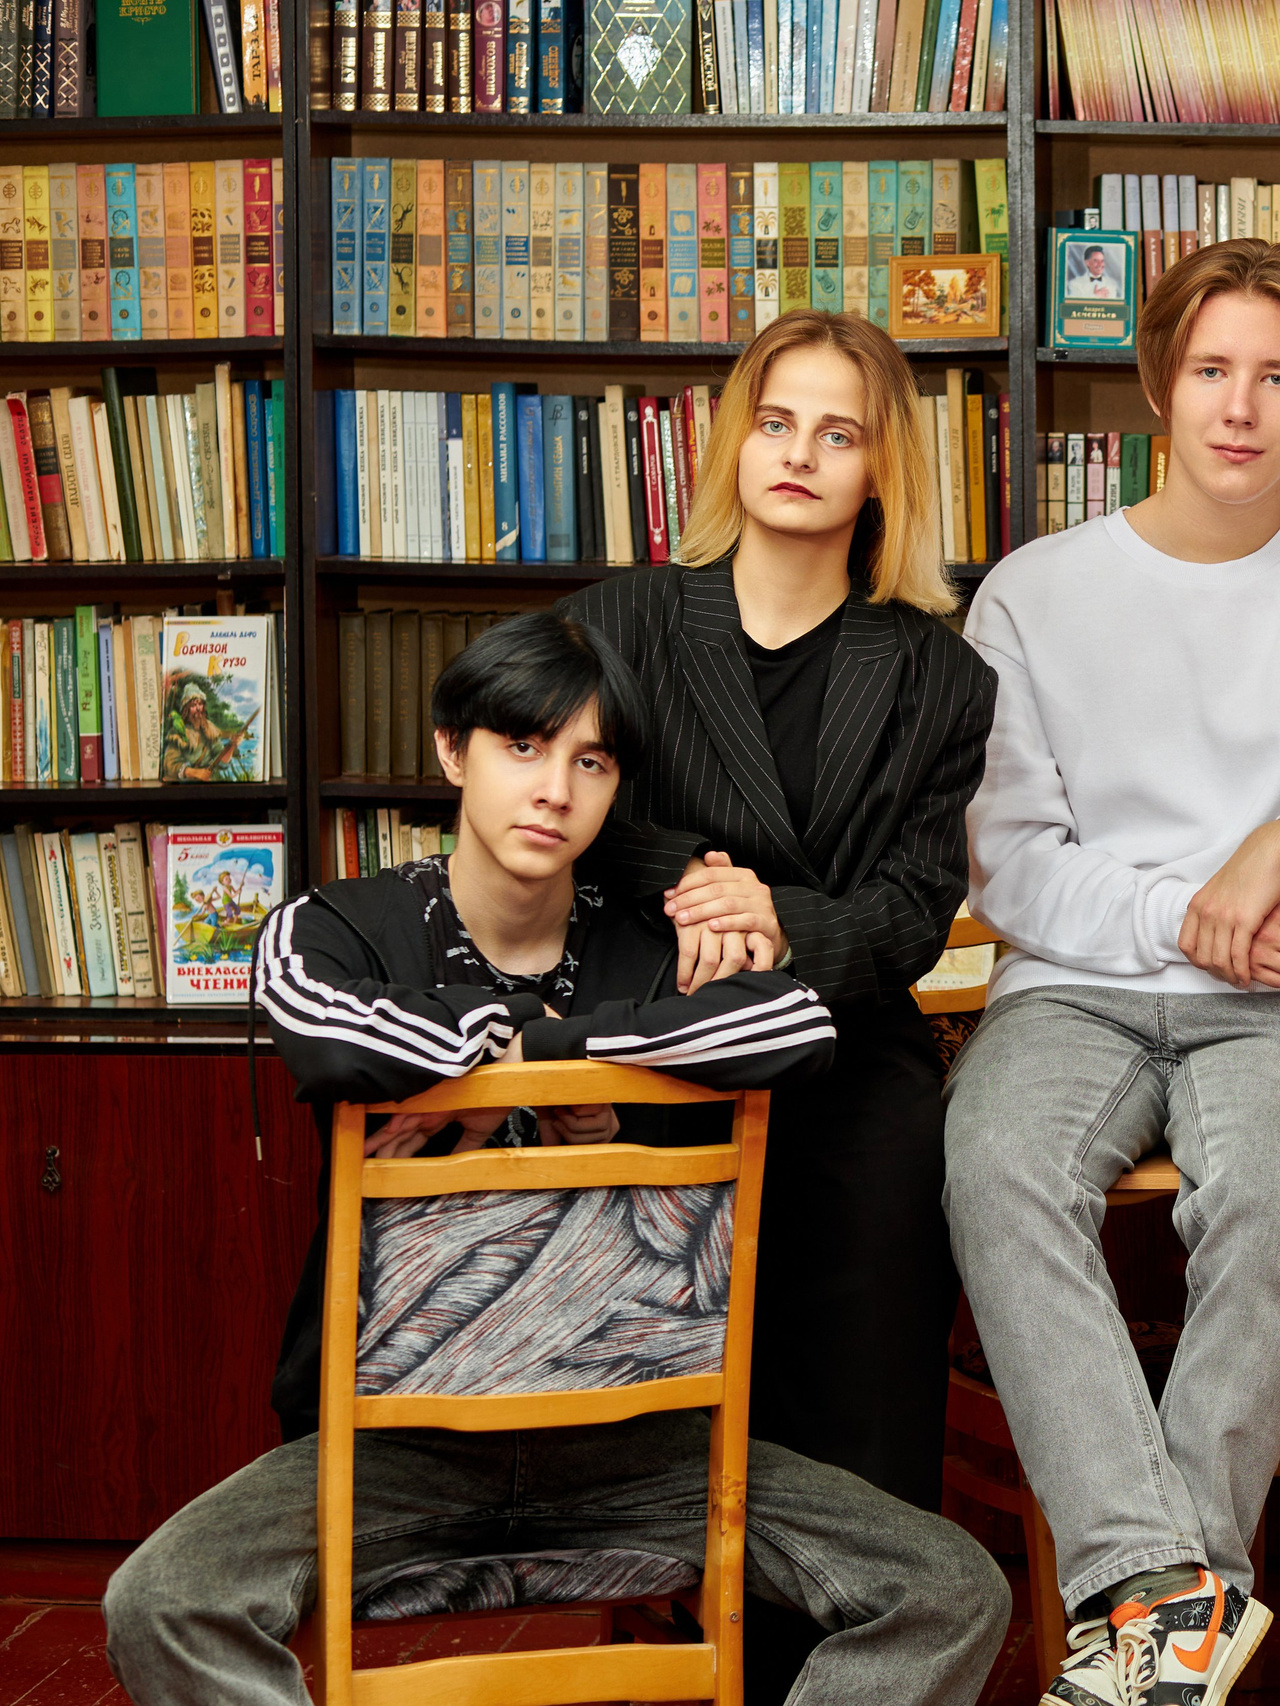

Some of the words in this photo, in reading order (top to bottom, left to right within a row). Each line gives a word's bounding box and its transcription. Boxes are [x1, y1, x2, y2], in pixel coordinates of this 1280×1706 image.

[119, 5, 167, 16] КРИСТО
[251, 13, 261, 81] ТАРЗА
[549, 46, 560, 88] ЗОЩЕНКО
[703, 42, 717, 91] ТОЛСТОЙ
[486, 41, 496, 95] ШОЛОХОВ
[498, 393, 508, 441] РАССОЛОВ
[500, 443, 508, 483] МИХАИЛ
[173, 631, 227, 656] РОБИНЗОН
[208, 655, 246, 677] КРУЗО
[178, 846, 192, 862] 5
[190, 978, 248, 991] ЧТЕНИ
